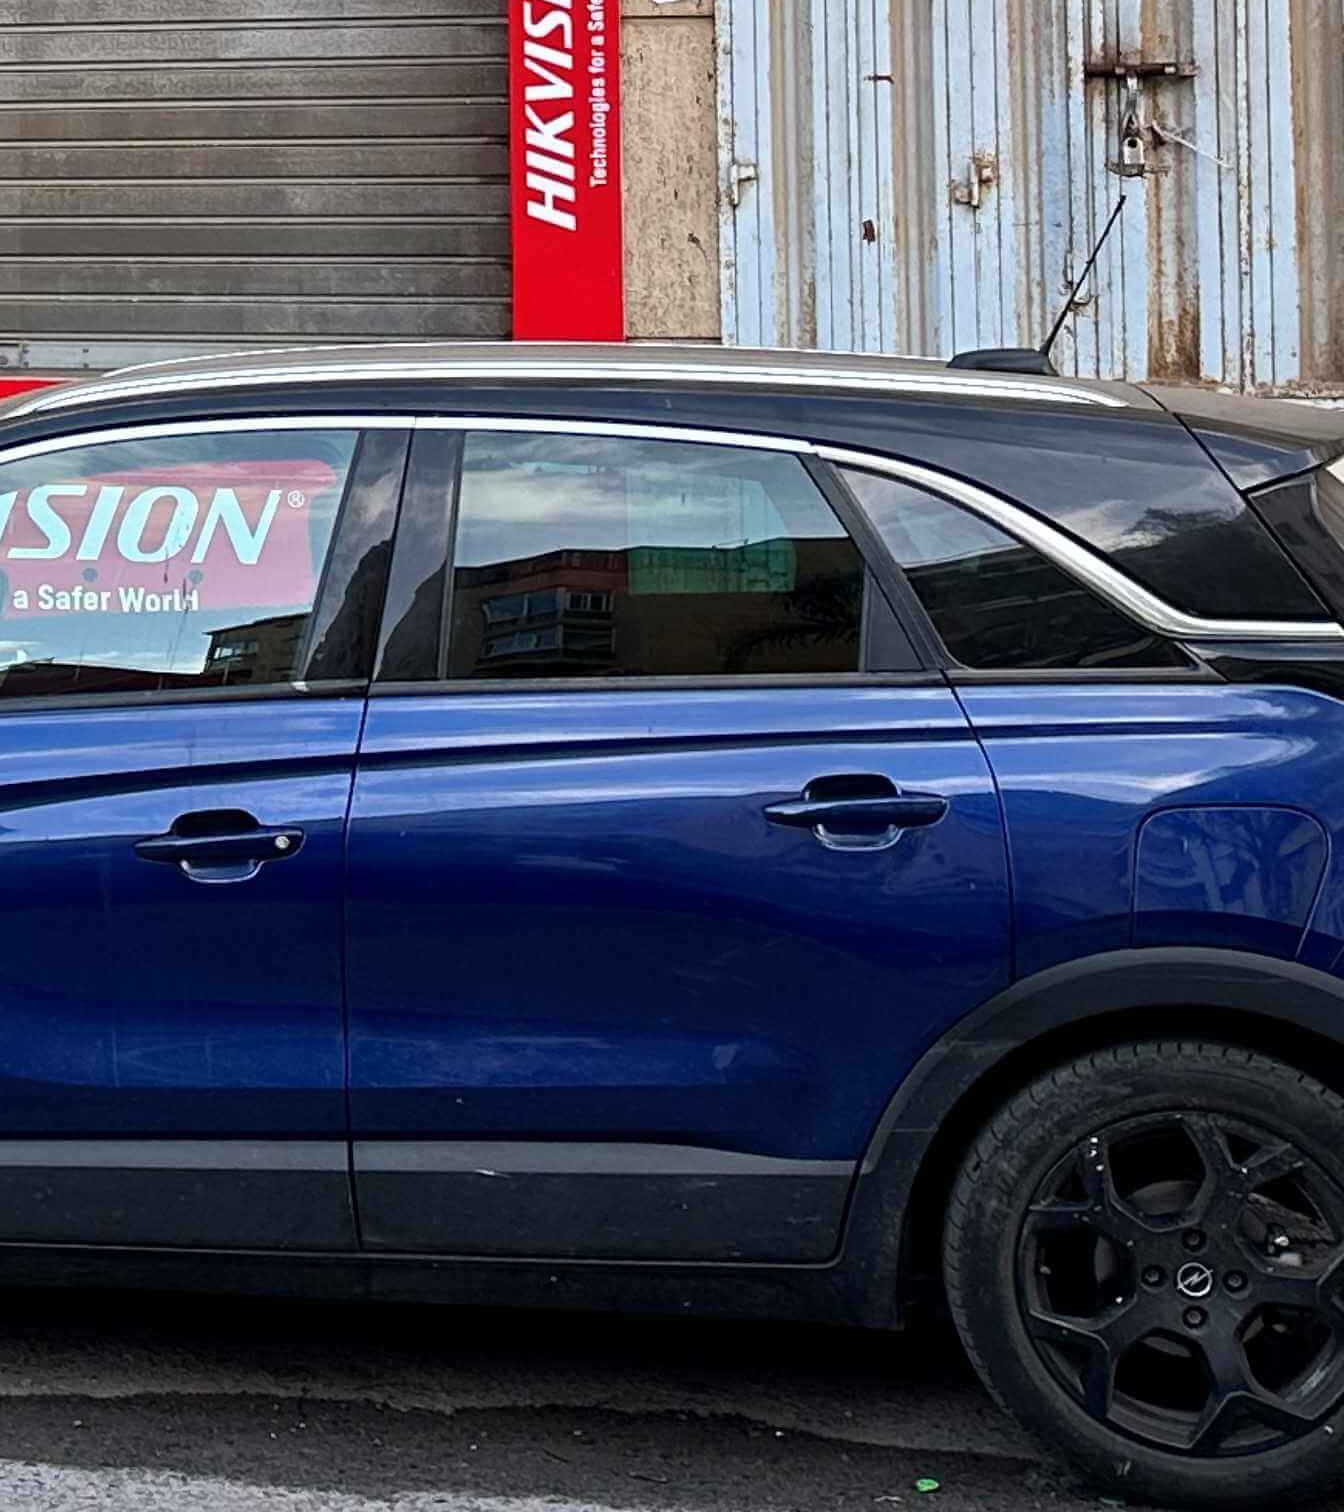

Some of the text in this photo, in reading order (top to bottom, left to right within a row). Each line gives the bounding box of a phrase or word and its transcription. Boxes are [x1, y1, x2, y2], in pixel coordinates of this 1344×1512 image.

[588, 49, 605, 74] for
[588, 77, 610, 187] Technologies
[13, 586, 199, 613] a Safer World
